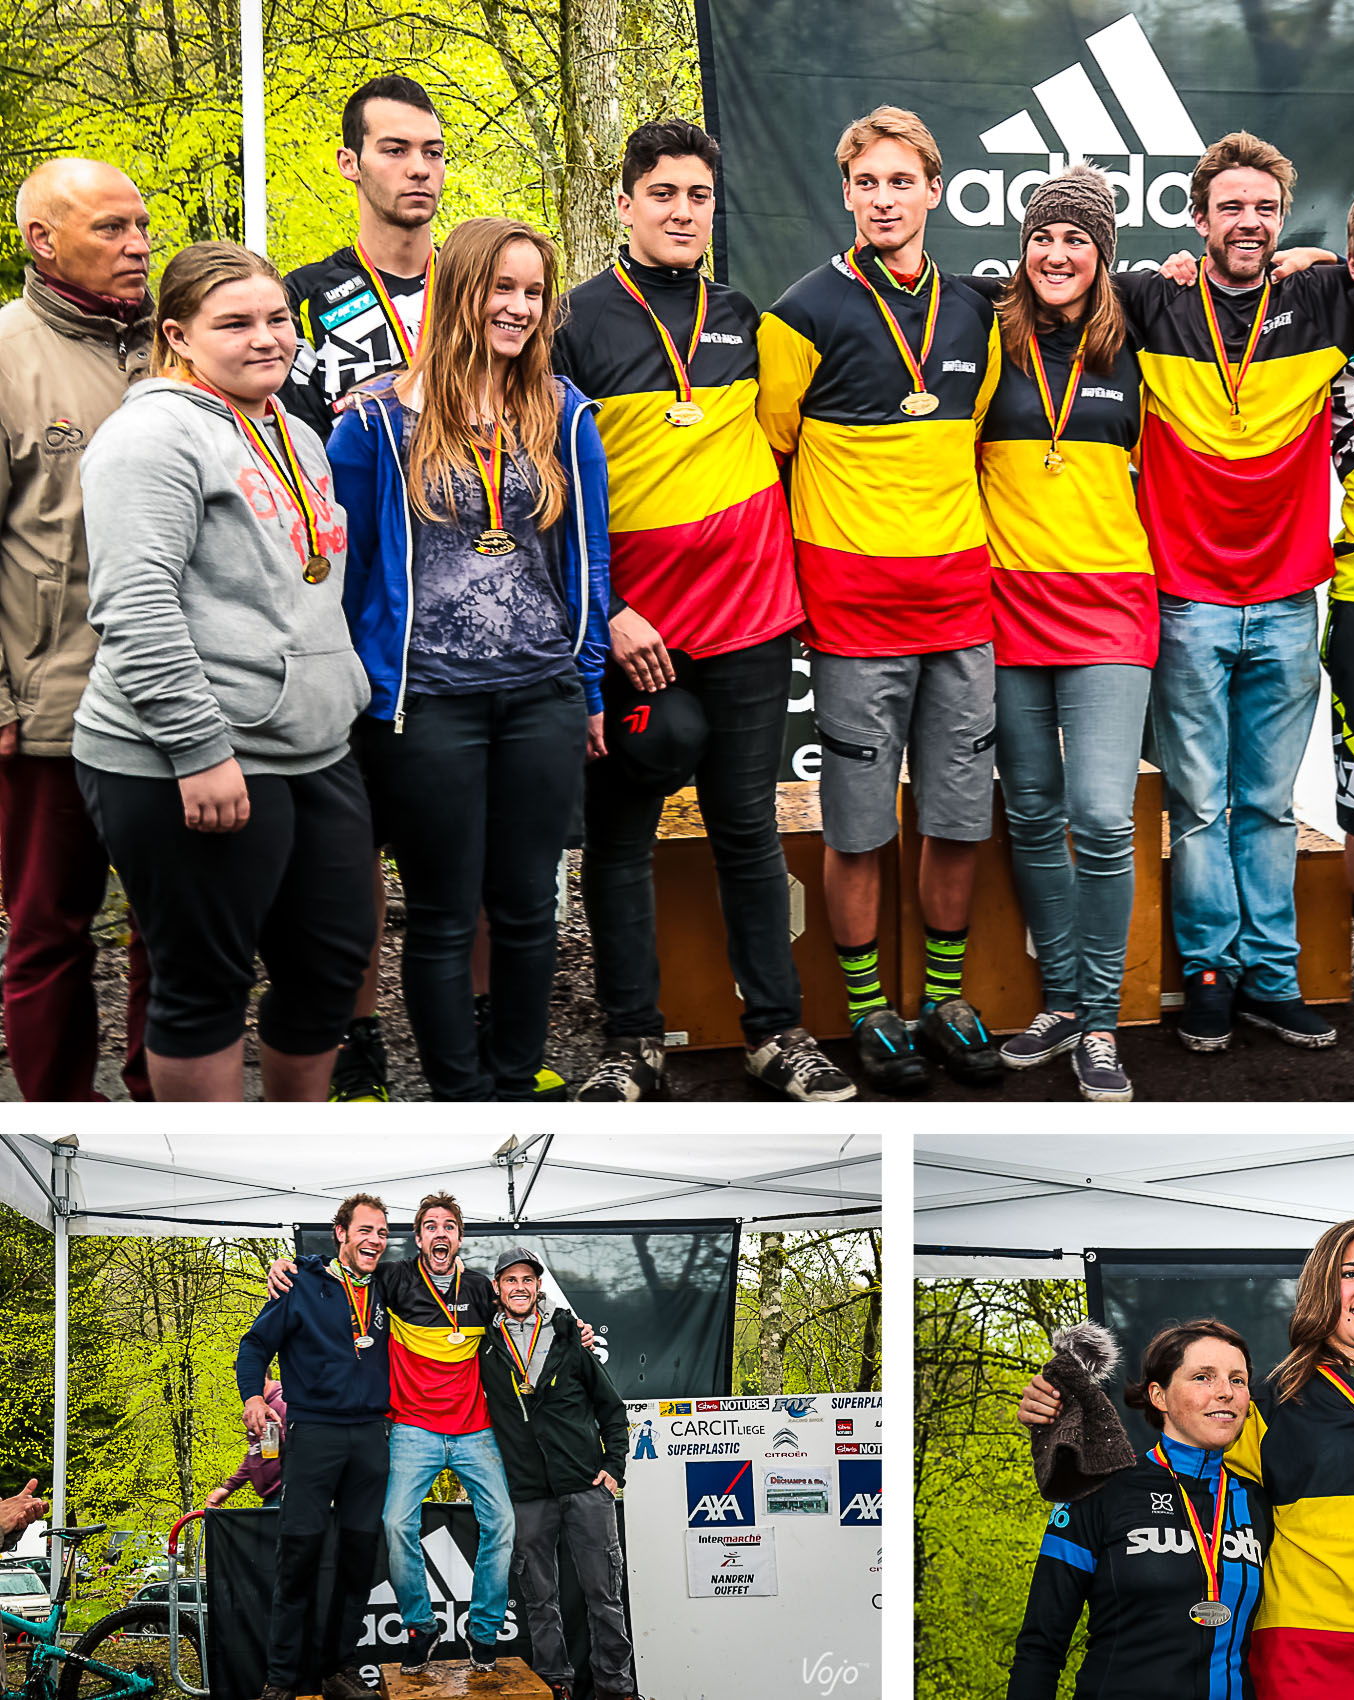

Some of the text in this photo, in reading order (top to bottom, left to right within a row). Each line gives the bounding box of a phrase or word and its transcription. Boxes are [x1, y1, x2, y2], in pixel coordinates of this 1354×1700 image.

[946, 152, 1195, 228] adda
[720, 1398, 769, 1411] NOTUBES
[771, 1397, 817, 1413] FOX
[831, 1396, 882, 1409] SUPERPLA
[671, 1420, 765, 1437] CARCIT LIEGE
[667, 1442, 740, 1456] SUPERPLASTIC
[859, 1443, 882, 1454] NOT
[688, 1494, 744, 1522] AXA
[710, 1574, 755, 1584] NANDRIN
[714, 1585, 750, 1595] OUFFET
